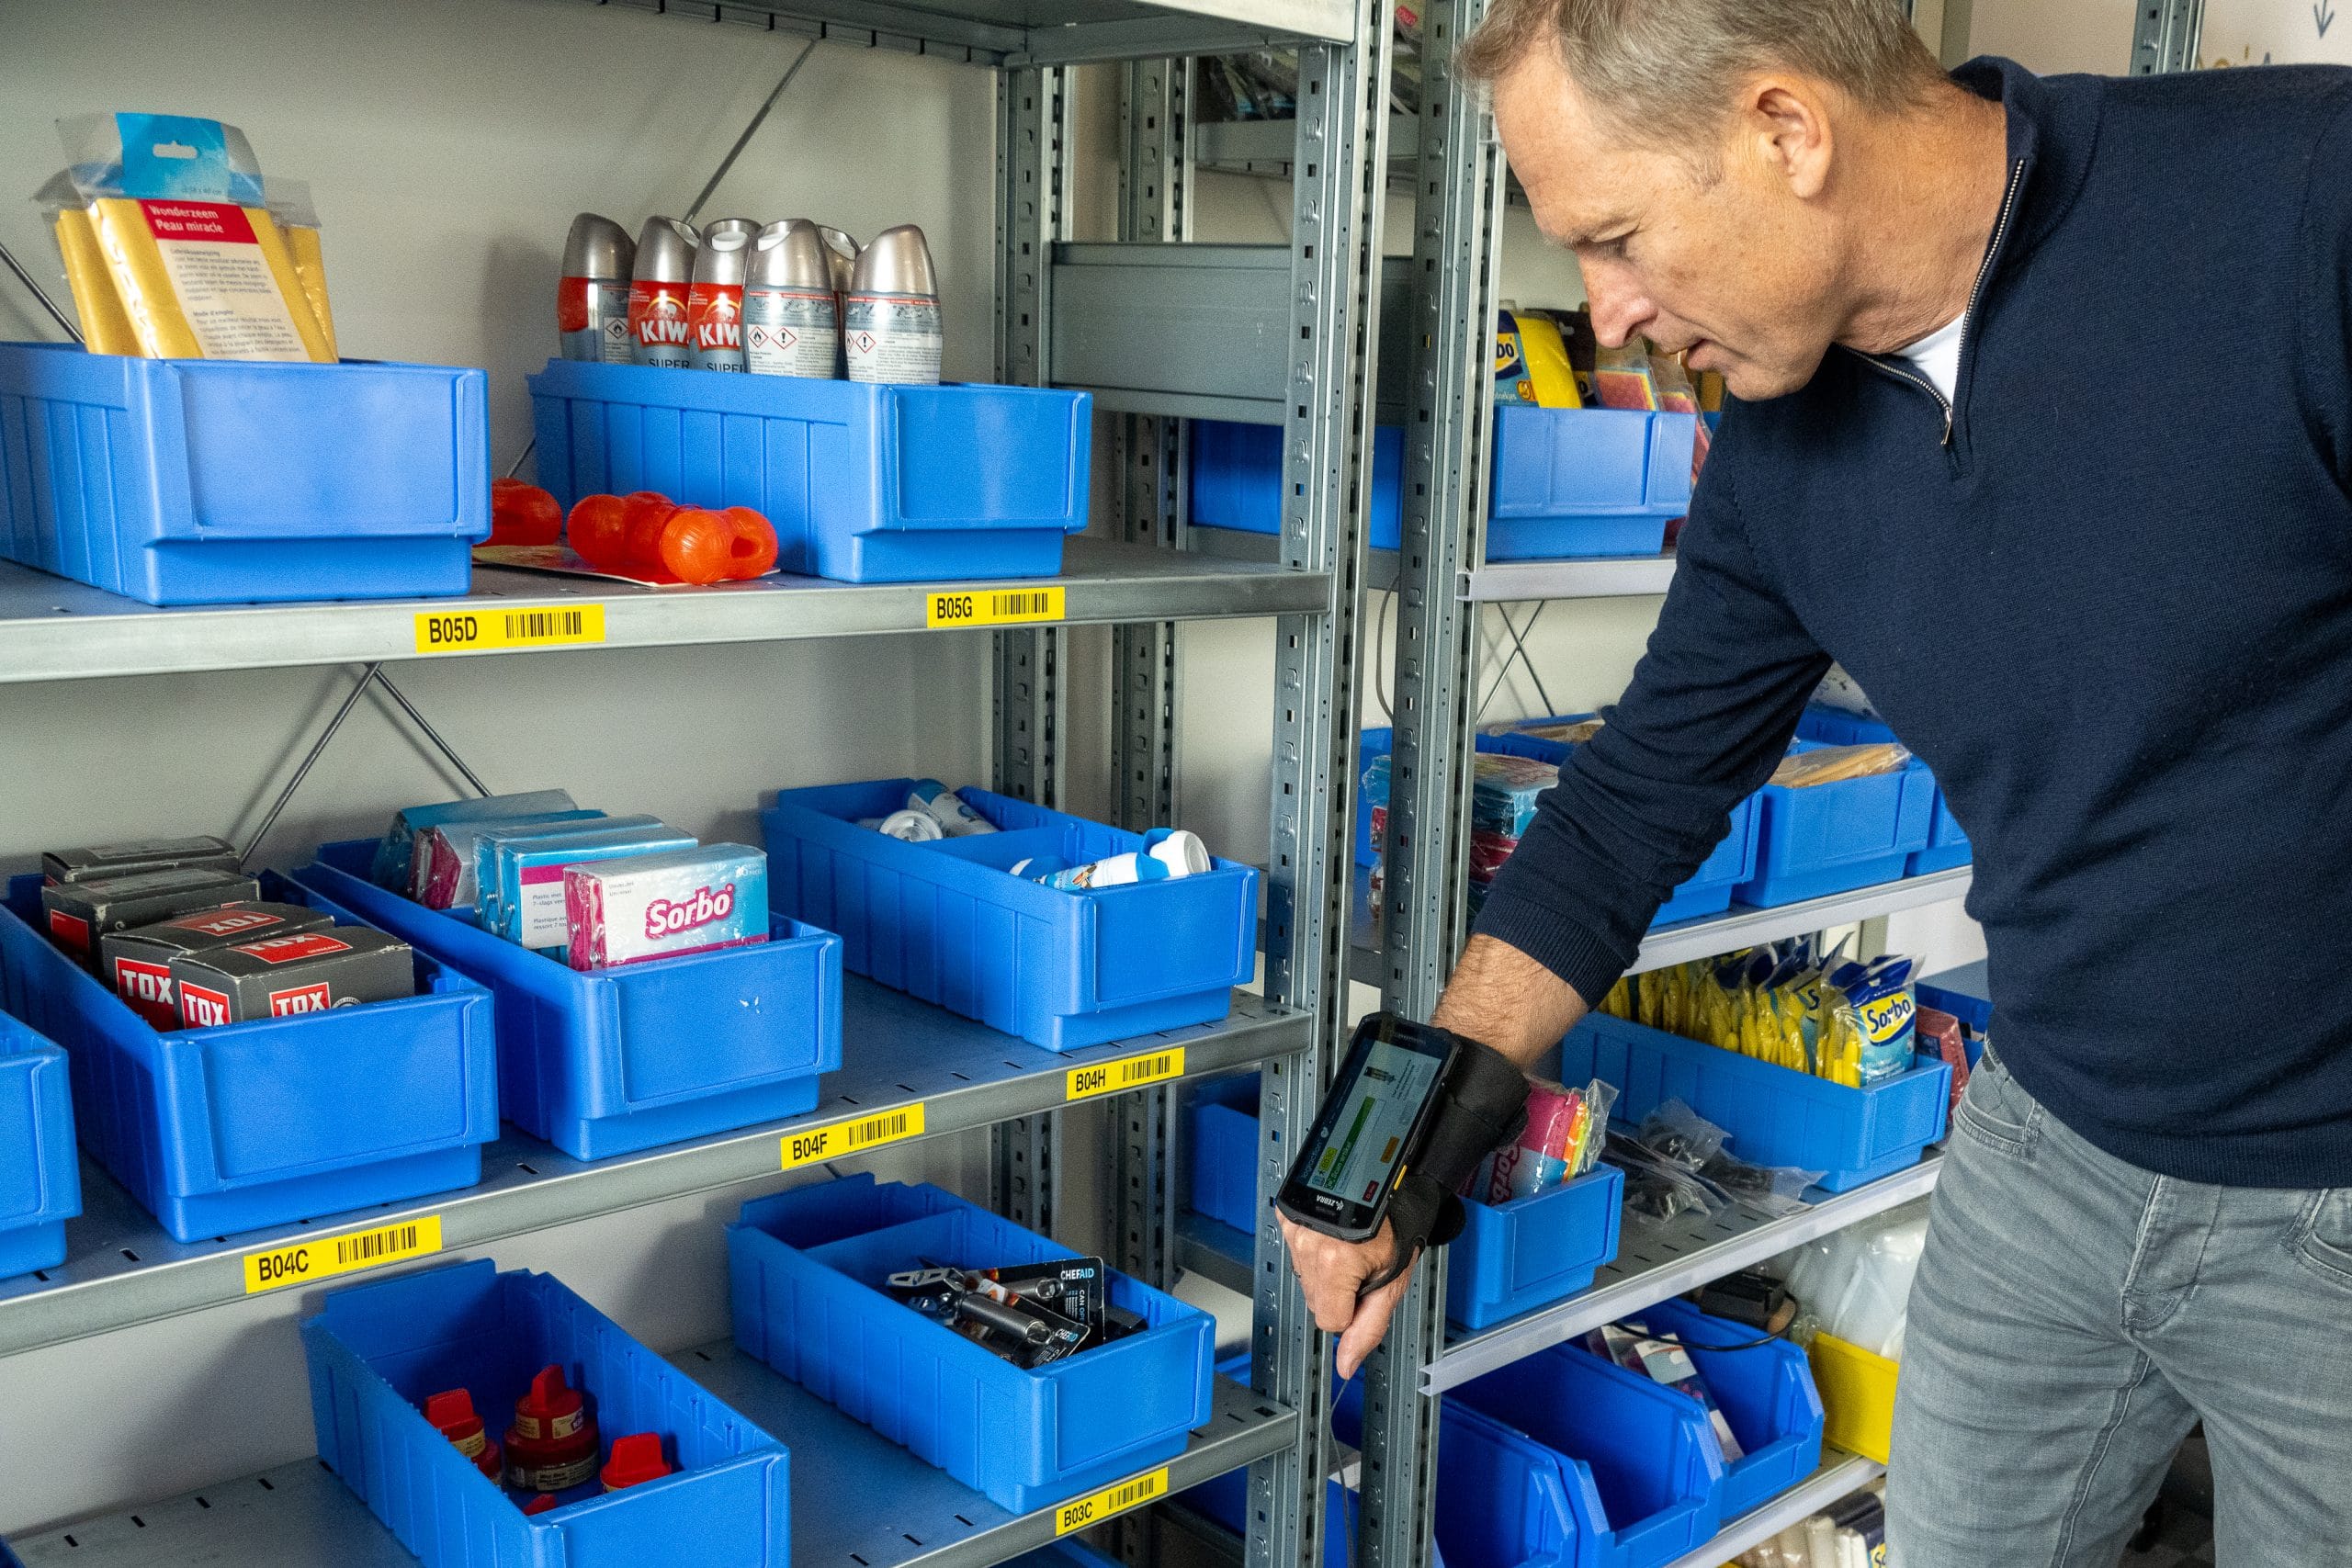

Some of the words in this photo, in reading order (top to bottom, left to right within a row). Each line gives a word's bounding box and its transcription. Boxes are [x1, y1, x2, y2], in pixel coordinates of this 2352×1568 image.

[148, 205, 220, 220] Wonderzeem
[154, 219, 185, 231] Peau
[186, 221, 225, 233] miracle
[640, 320, 689, 344] KIW
[699, 322, 741, 346] KIW
[707, 362, 743, 373] SUPE
[936, 596, 973, 620] B05G
[428, 616, 478, 644] B05D
[647, 887, 733, 936] Sorbo
[239, 934, 319, 952] TOX
[121, 969, 174, 1005] TOX
[185, 993, 225, 1027] TOX
[276, 991, 325, 1017] TOX
[1866, 998, 1911, 1034] Sorbo
[1076, 1068, 1106, 1092] B04H
[793, 1133, 828, 1161] B04F
[1316, 1194, 1336, 1207] ZEBRA
[258, 1249, 310, 1281] B04C
[1060, 1268, 1095, 1280] CHEFAID
[1064, 1502, 1093, 1528] B03C
